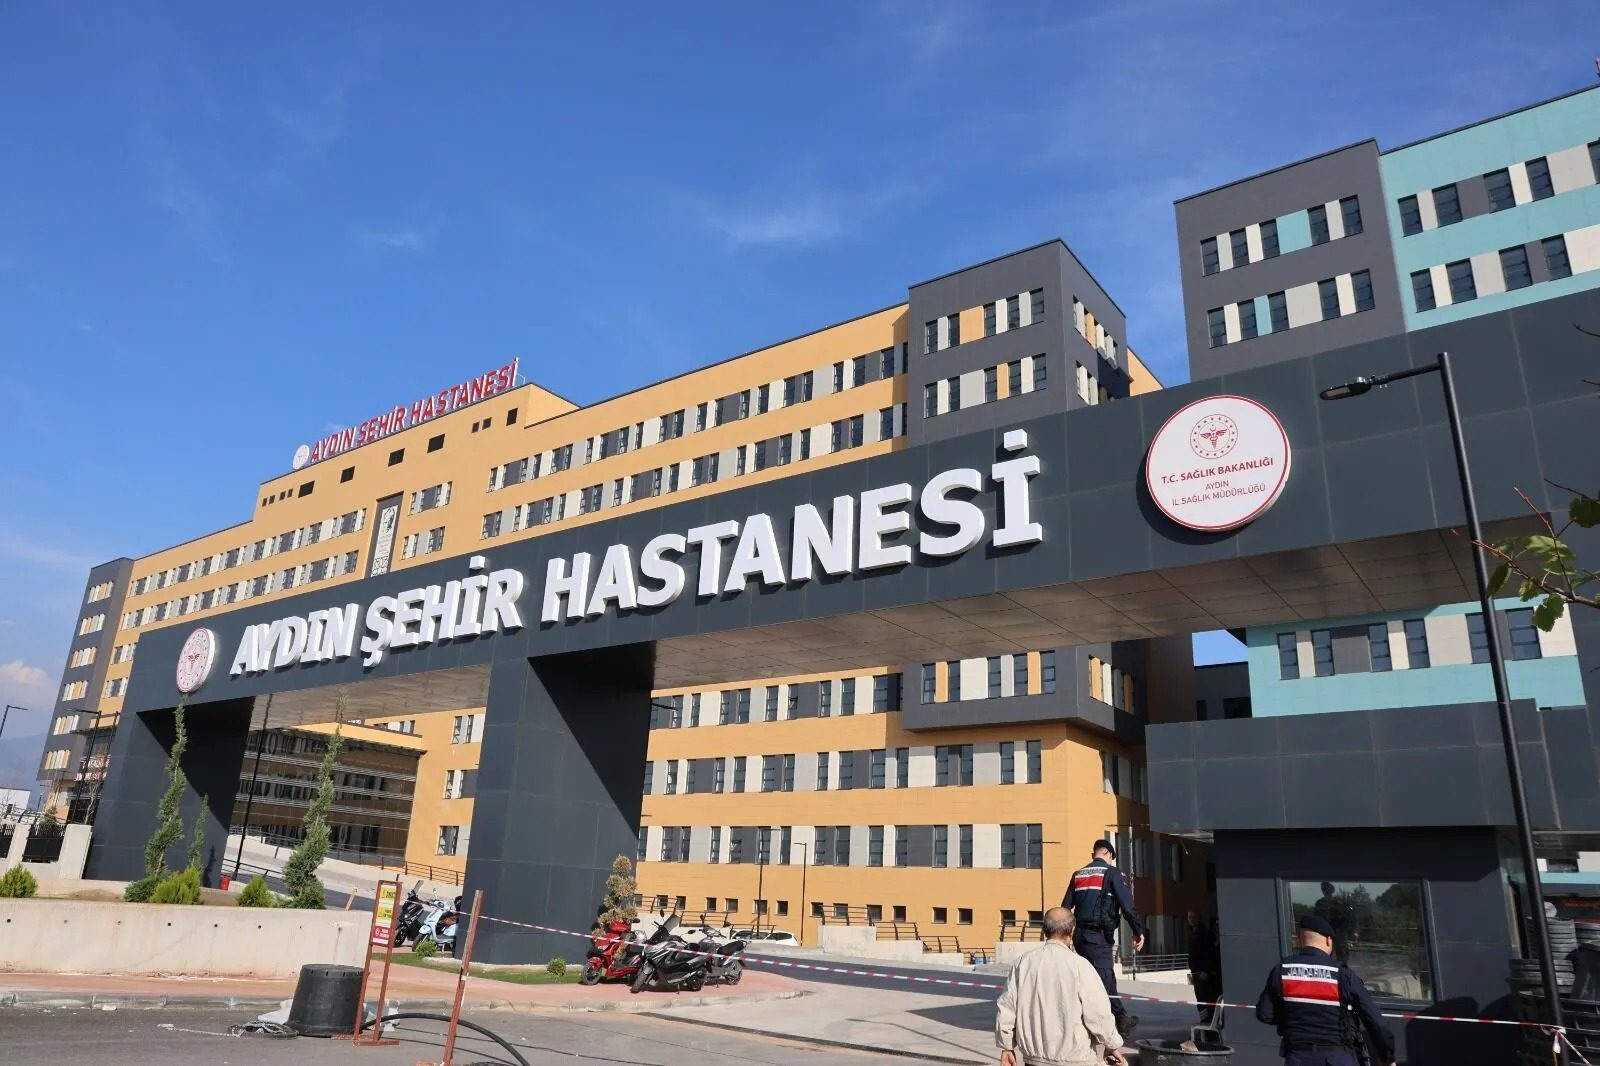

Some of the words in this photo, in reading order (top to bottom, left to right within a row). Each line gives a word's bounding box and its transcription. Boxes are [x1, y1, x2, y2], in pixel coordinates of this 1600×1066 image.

[310, 425, 357, 463] AYDIN
[356, 404, 408, 447] ŞEHİR
[409, 356, 519, 425] HASTANESİ
[1161, 474, 1179, 485] T.C.
[1180, 467, 1216, 482] SAĞLIK
[1217, 456, 1274, 475] BAKANLIĞI
[1172, 497, 1181, 506] İL
[1181, 492, 1211, 505] SAĞLIK
[1212, 482, 1266, 500] MÜDÜRLÜĞÜ
[1205, 479, 1230, 490] AYDIN
[229, 603, 361, 675] AYDIN
[360, 555, 524, 668] ŞEHİR
[541, 428, 1043, 624] HASTANESİ
[1287, 966, 1332, 979] JANDARMA
